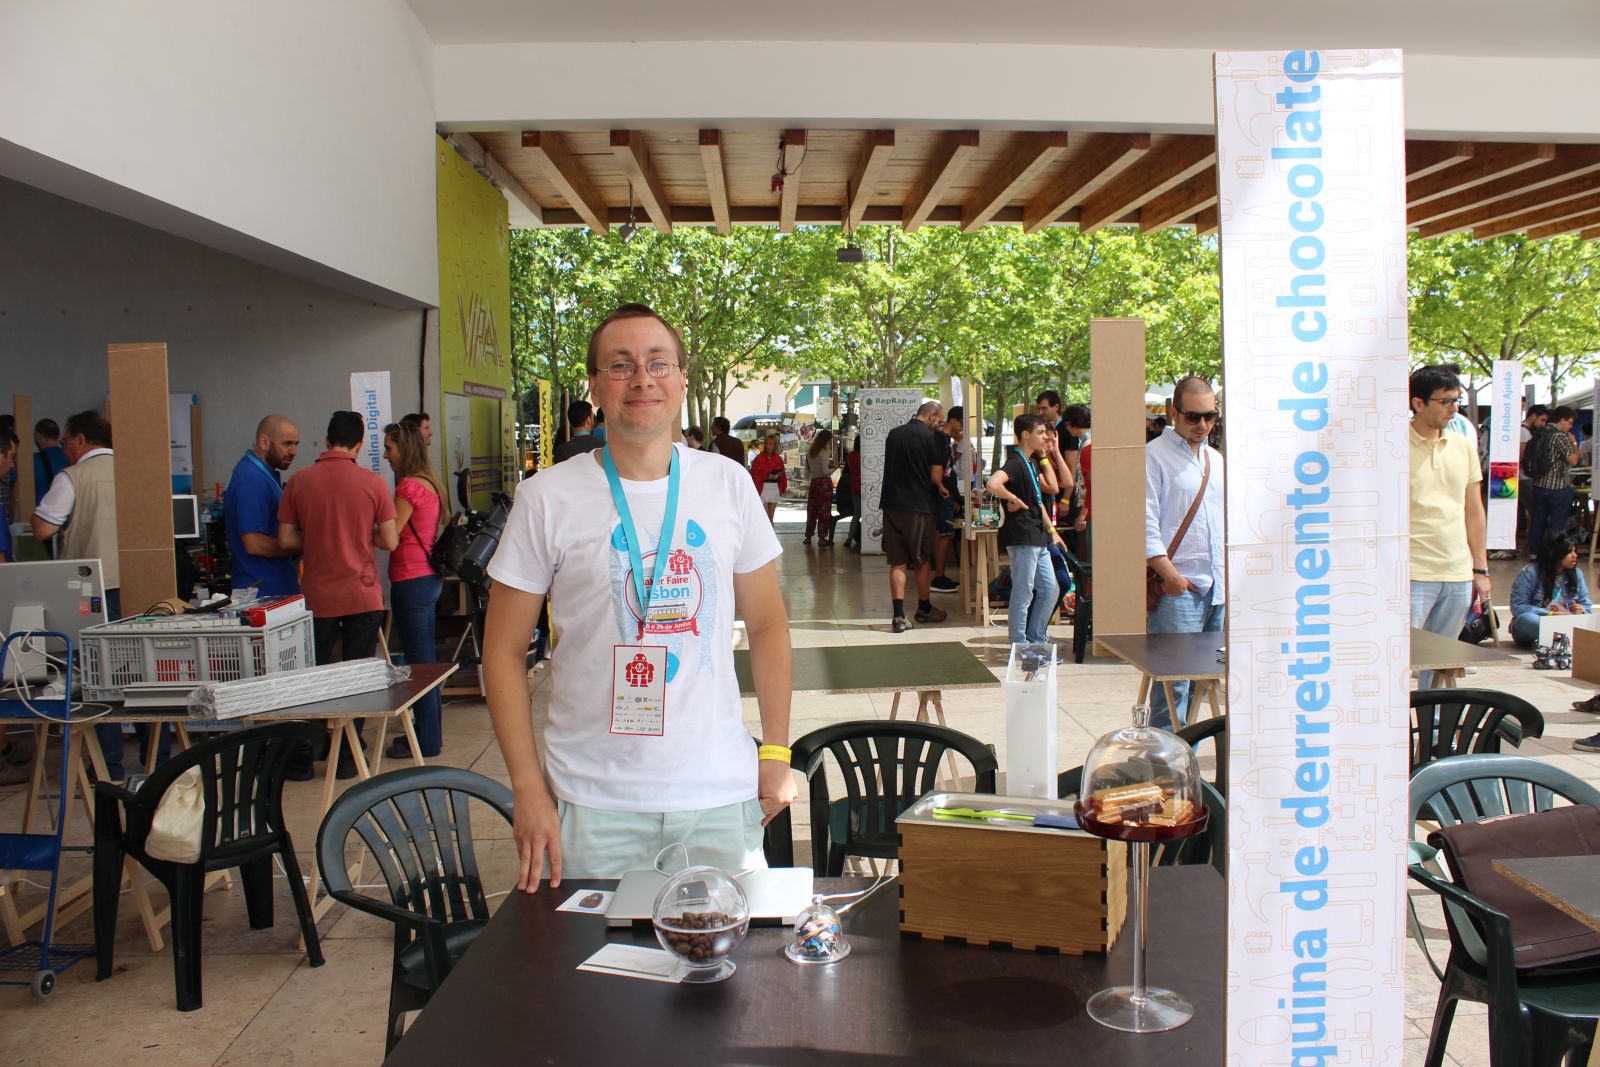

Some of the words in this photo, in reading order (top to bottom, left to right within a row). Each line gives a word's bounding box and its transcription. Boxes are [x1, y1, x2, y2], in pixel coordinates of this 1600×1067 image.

[1271, 48, 1328, 342] chocolate
[1277, 361, 1329, 432] de
[1503, 371, 1514, 400] Ajuda
[365, 390, 380, 430] Digital
[1502, 402, 1511, 432] Robot
[367, 434, 381, 474] nalina
[1501, 434, 1510, 442] O
[667, 576, 688, 585] Faire
[1280, 450, 1331, 828] derretimento
[1280, 845, 1329, 911] de
